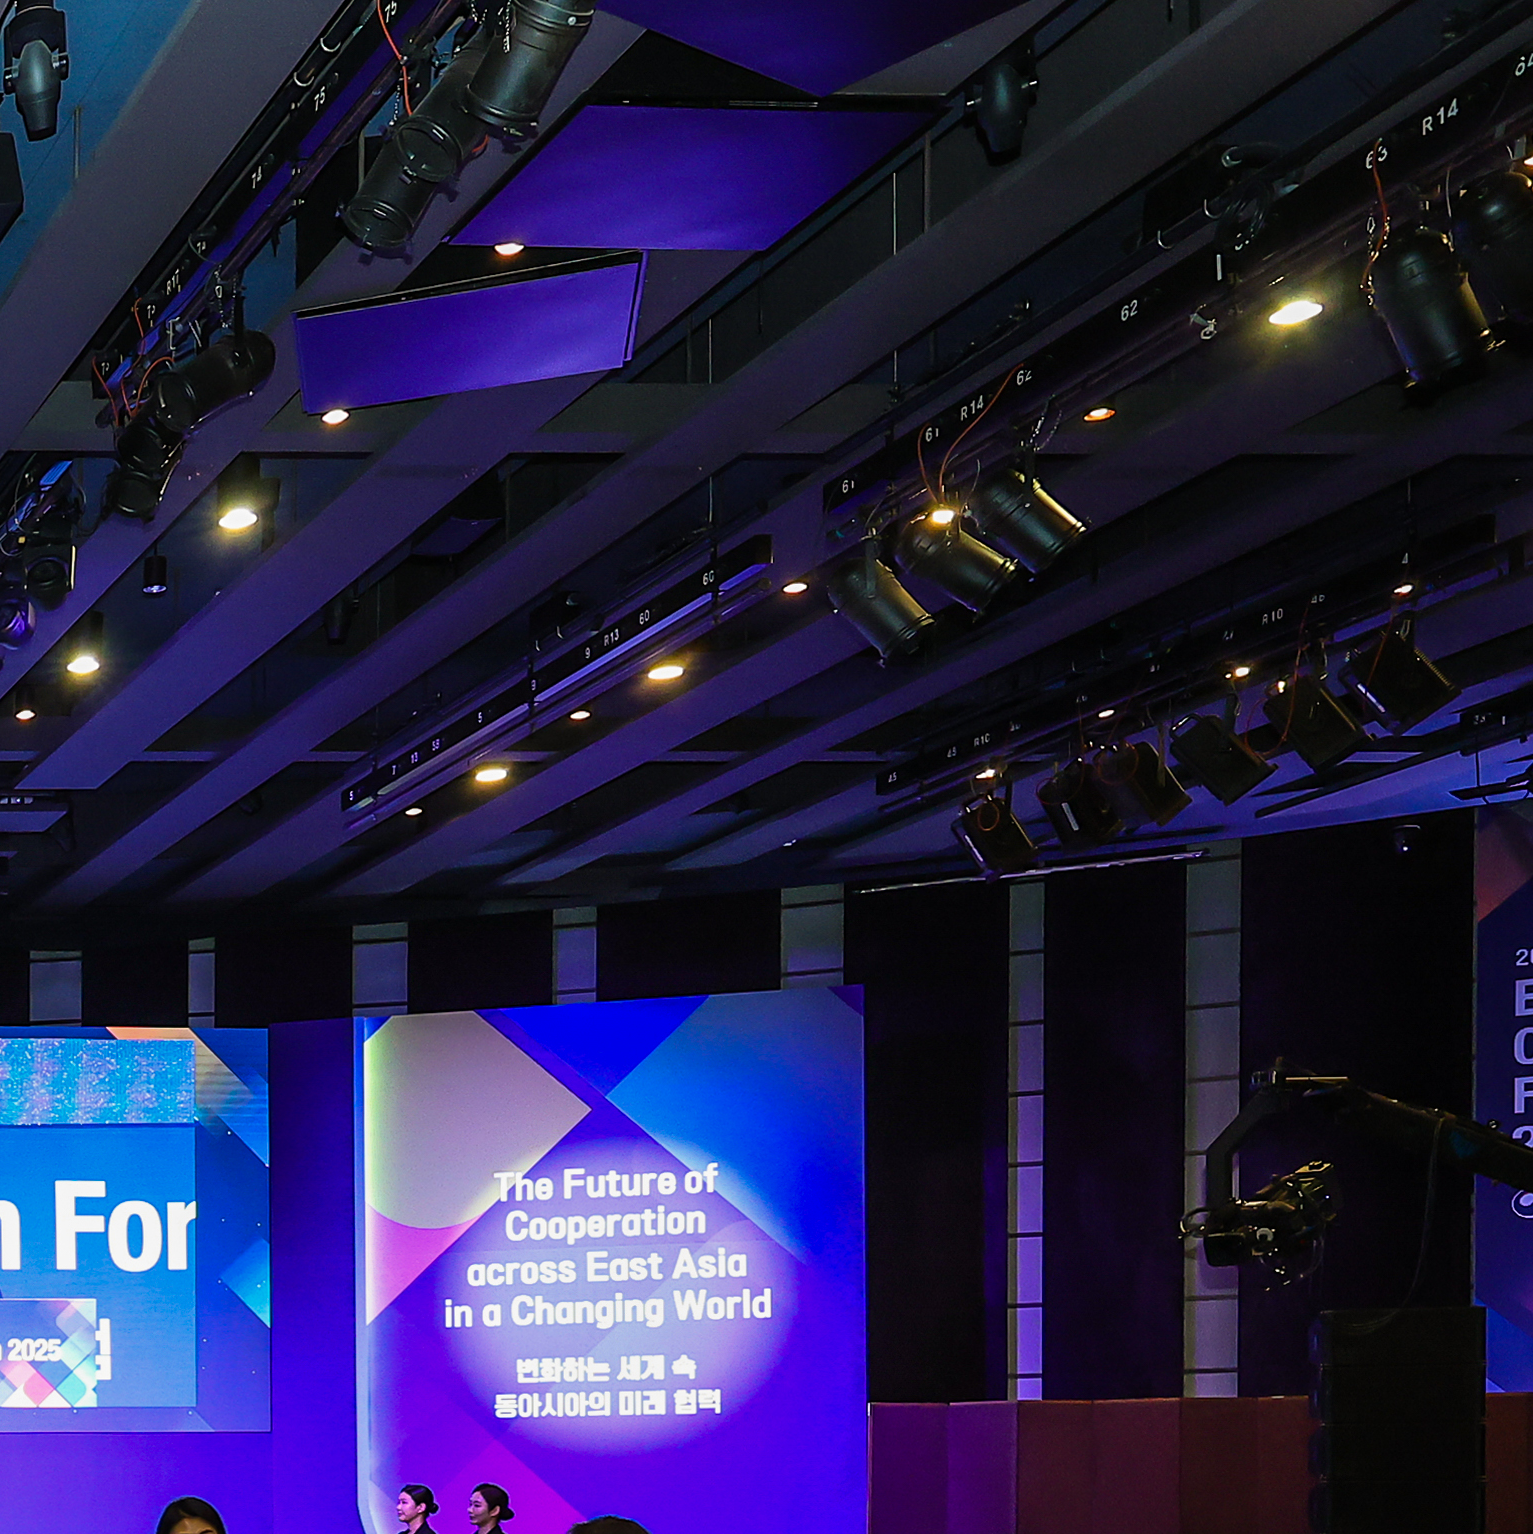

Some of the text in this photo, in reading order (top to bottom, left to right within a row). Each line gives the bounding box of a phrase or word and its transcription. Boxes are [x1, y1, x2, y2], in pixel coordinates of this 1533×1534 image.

[1421, 97, 1460, 136] R14
[1120, 299, 1139, 322] 62
[960, 394, 984, 423] R14
[493, 1162, 719, 1202] The Future of
[505, 1205, 706, 1245] Cooperation
[467, 1247, 747, 1287] across East Asia
[444, 1288, 773, 1329] in a Changing World
[7, 1338, 63, 1362] 2025
[516, 1354, 697, 1384] 변화하는 세계 속
[494, 1388, 722, 1419] 동아시아의 미래 협력
